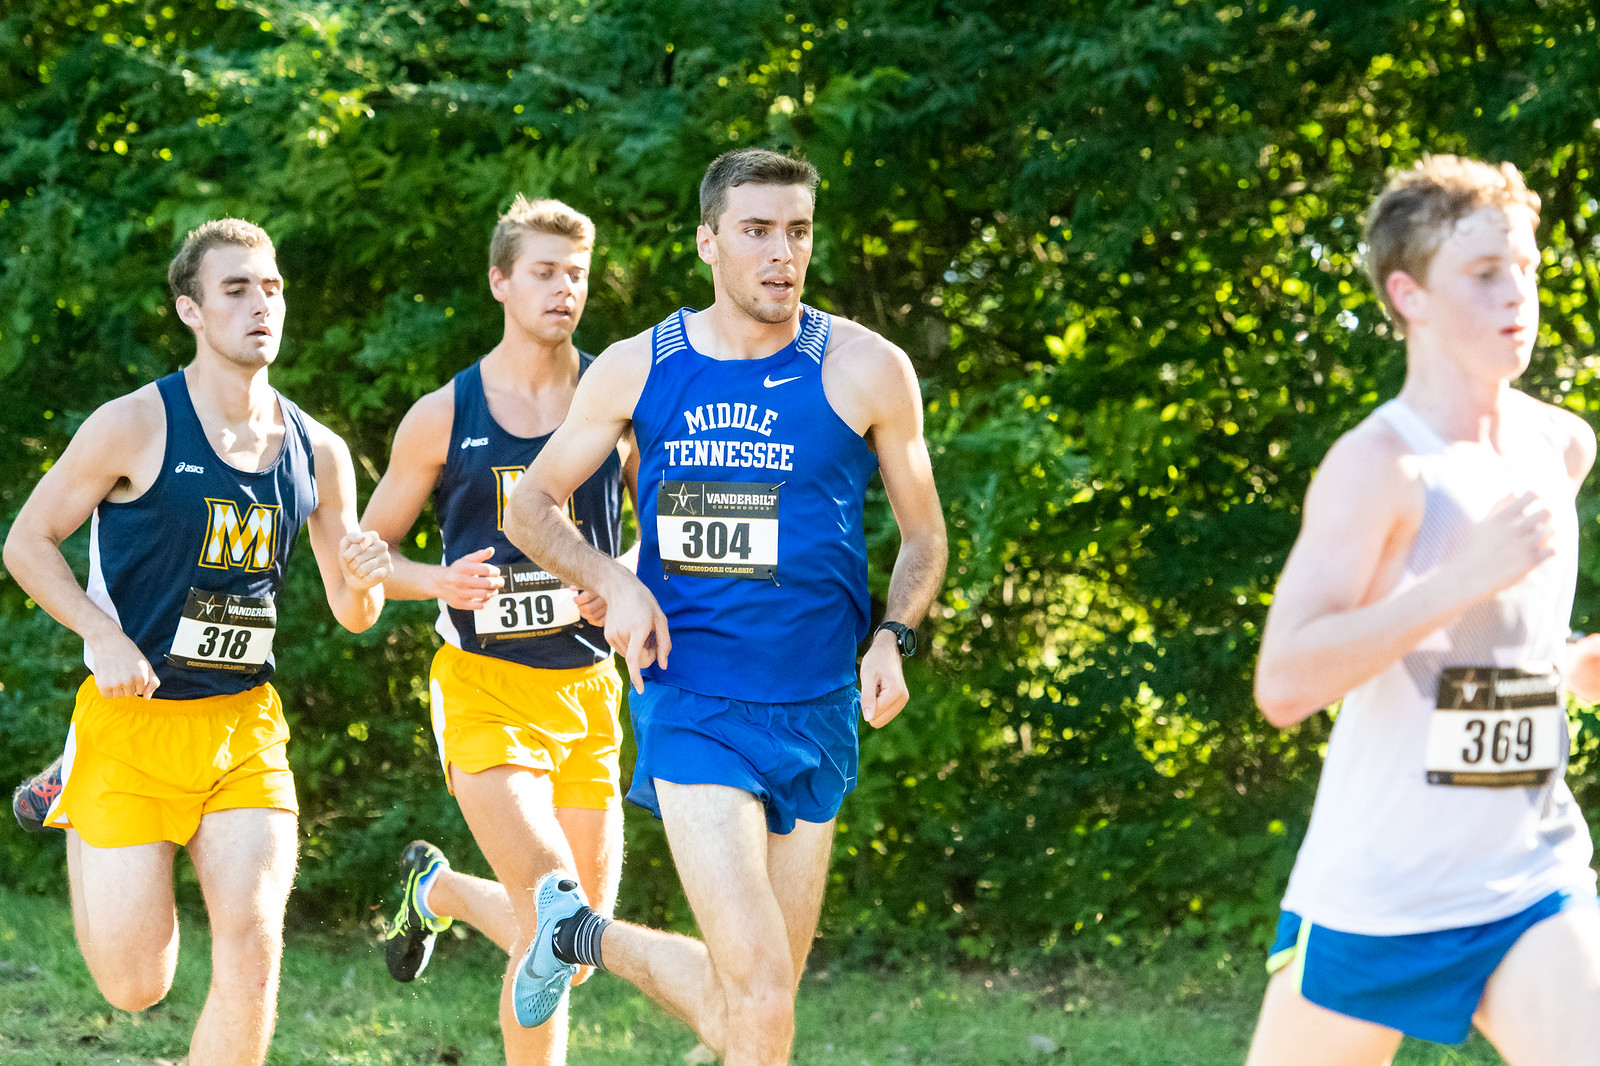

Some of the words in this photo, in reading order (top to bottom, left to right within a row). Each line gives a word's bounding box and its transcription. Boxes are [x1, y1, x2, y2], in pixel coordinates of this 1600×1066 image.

[683, 402, 779, 437] MIDDLE
[185, 464, 204, 474] asics
[664, 440, 795, 471] TENNESSEE
[706, 493, 777, 506] VANDERBILT
[198, 497, 281, 573] M
[682, 520, 752, 560] 304
[513, 570, 559, 583] VANDE
[679, 564, 724, 573] COMMODORE
[724, 566, 754, 574] CLASSIC
[227, 605, 275, 618] VANDERBIL
[499, 594, 555, 628] 319
[197, 626, 252, 660] 318
[1462, 717, 1532, 764] 369
